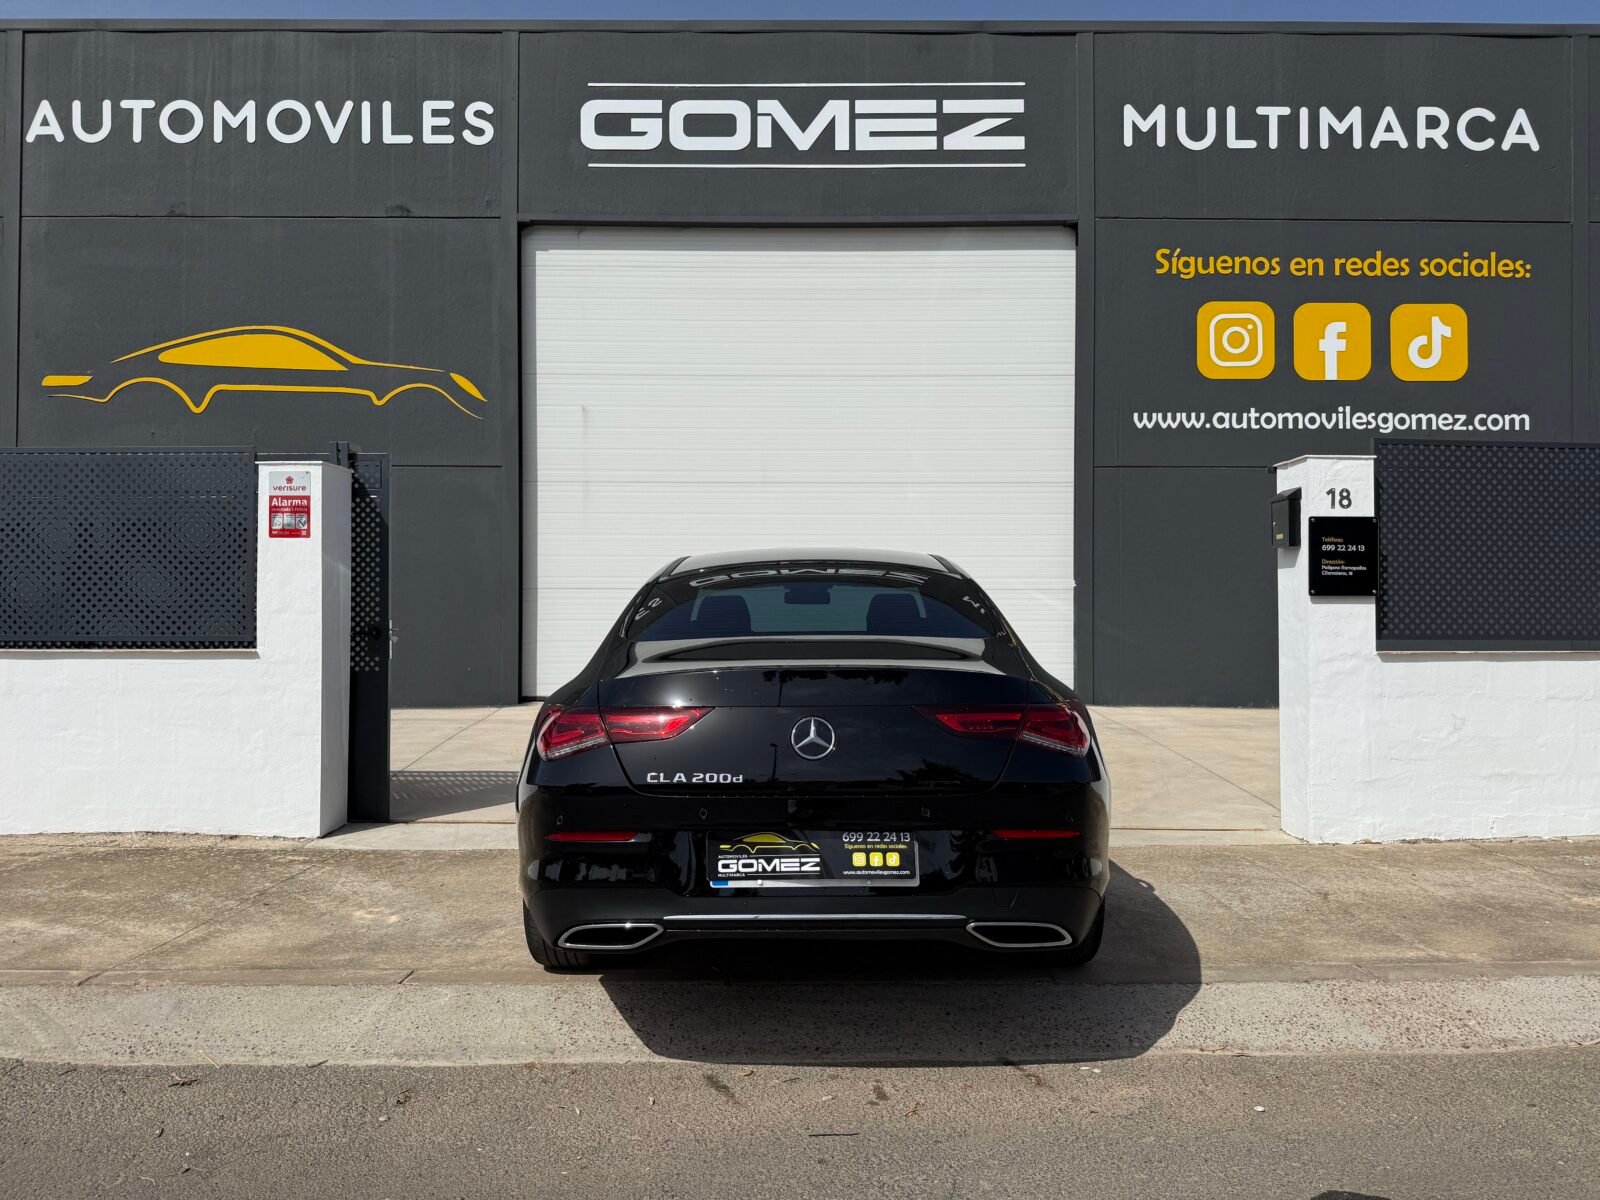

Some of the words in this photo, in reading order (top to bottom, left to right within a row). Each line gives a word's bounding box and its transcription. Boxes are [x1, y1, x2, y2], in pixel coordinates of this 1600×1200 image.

[26, 99, 495, 146] AUTOMOVILES
[580, 99, 1026, 151] GOMEZ
[1123, 103, 1540, 152] MULTIMARCA
[1155, 248, 1281, 279] Síguenos
[1289, 257, 1325, 277] en
[1334, 251, 1411, 277] redes
[1419, 251, 1532, 279] sociales:
[1133, 406, 1531, 434] www.automovilesgomez.com
[272, 497, 307, 506] Alarma
[1325, 487, 1352, 510] 18
[1321, 544, 1336, 552] 699
[1337, 544, 1346, 552] 22
[1347, 544, 1357, 552] 24
[646, 772, 687, 783] CLA
[691, 772, 743, 784] 200d
[842, 832, 864, 842] 699
[866, 832, 881, 842] 22
[883, 832, 897, 842] 24
[900, 832, 911, 842] 13
[717, 857, 821, 873] GOMEZ
